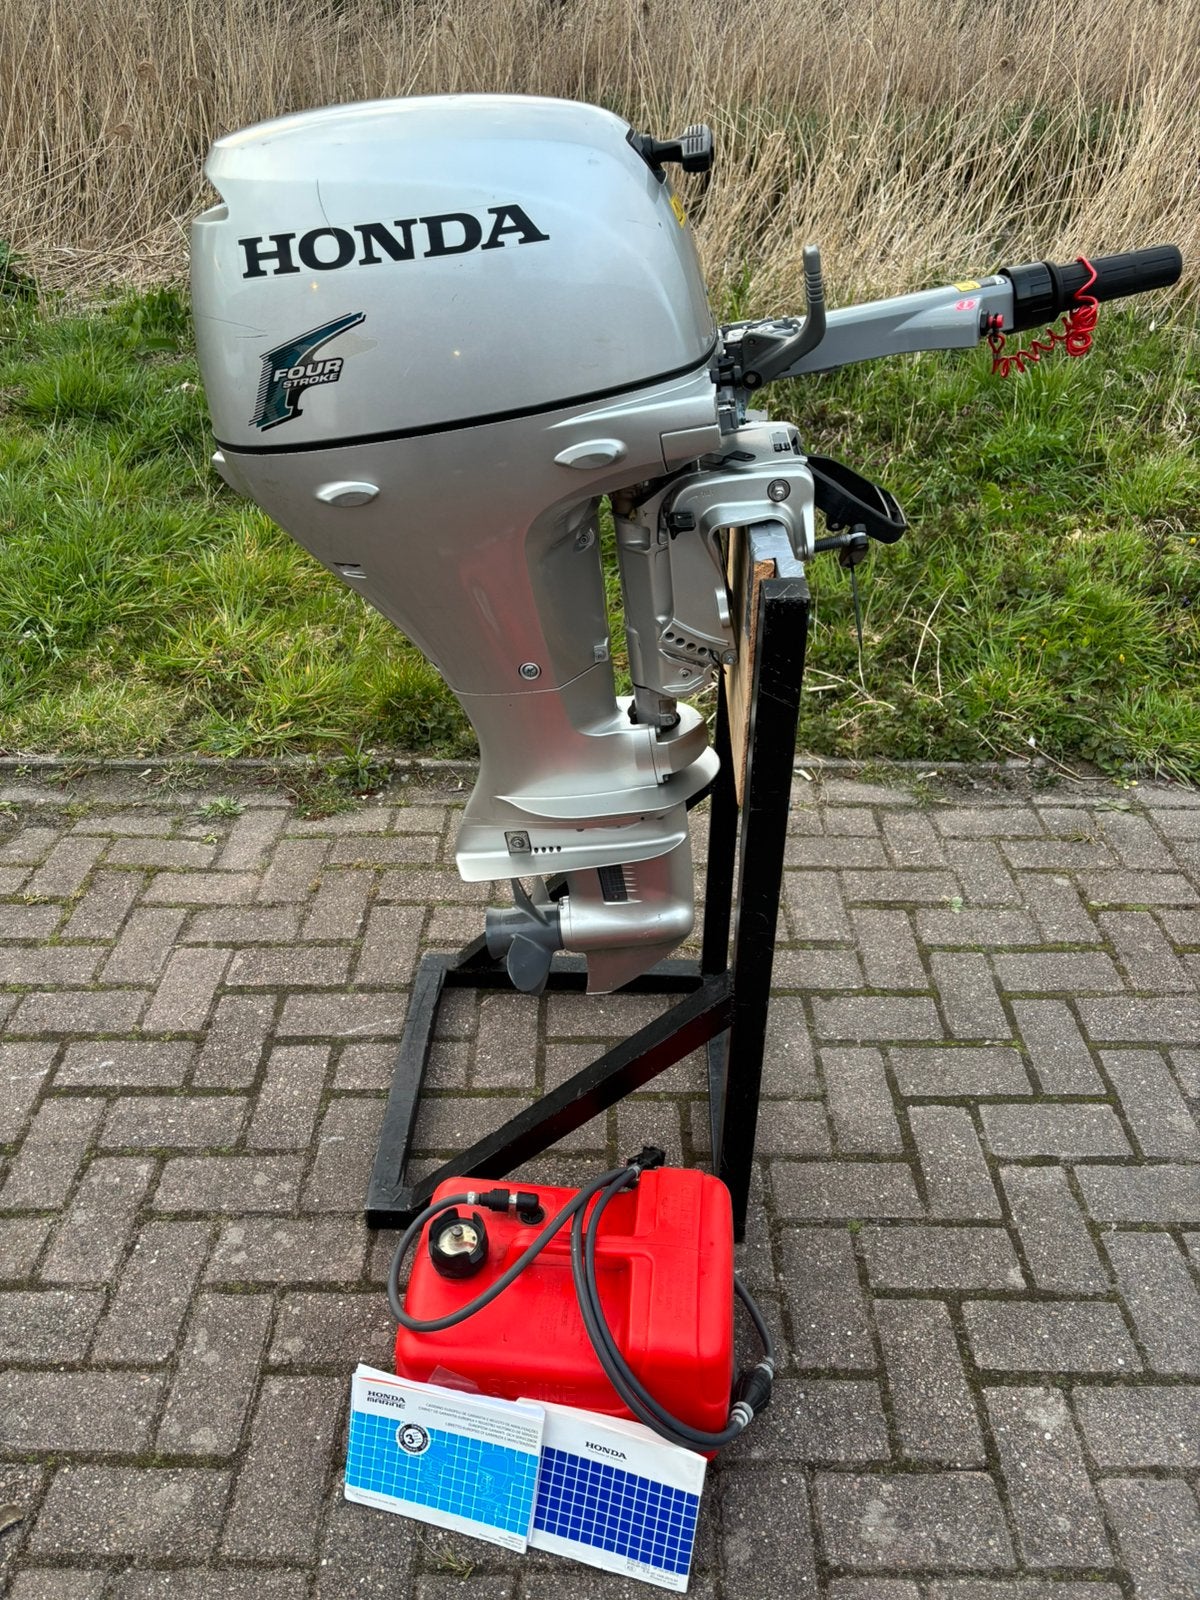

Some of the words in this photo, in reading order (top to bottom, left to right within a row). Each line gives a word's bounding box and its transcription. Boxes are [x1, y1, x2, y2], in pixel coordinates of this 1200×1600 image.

[238, 203, 549, 278] HONDA
[273, 357, 343, 381] FOUR
[283, 371, 339, 389] STROKE
[367, 1390, 406, 1403] HONDA
[405, 1433, 415, 1444] 3
[585, 1440, 628, 1460] HONDA
